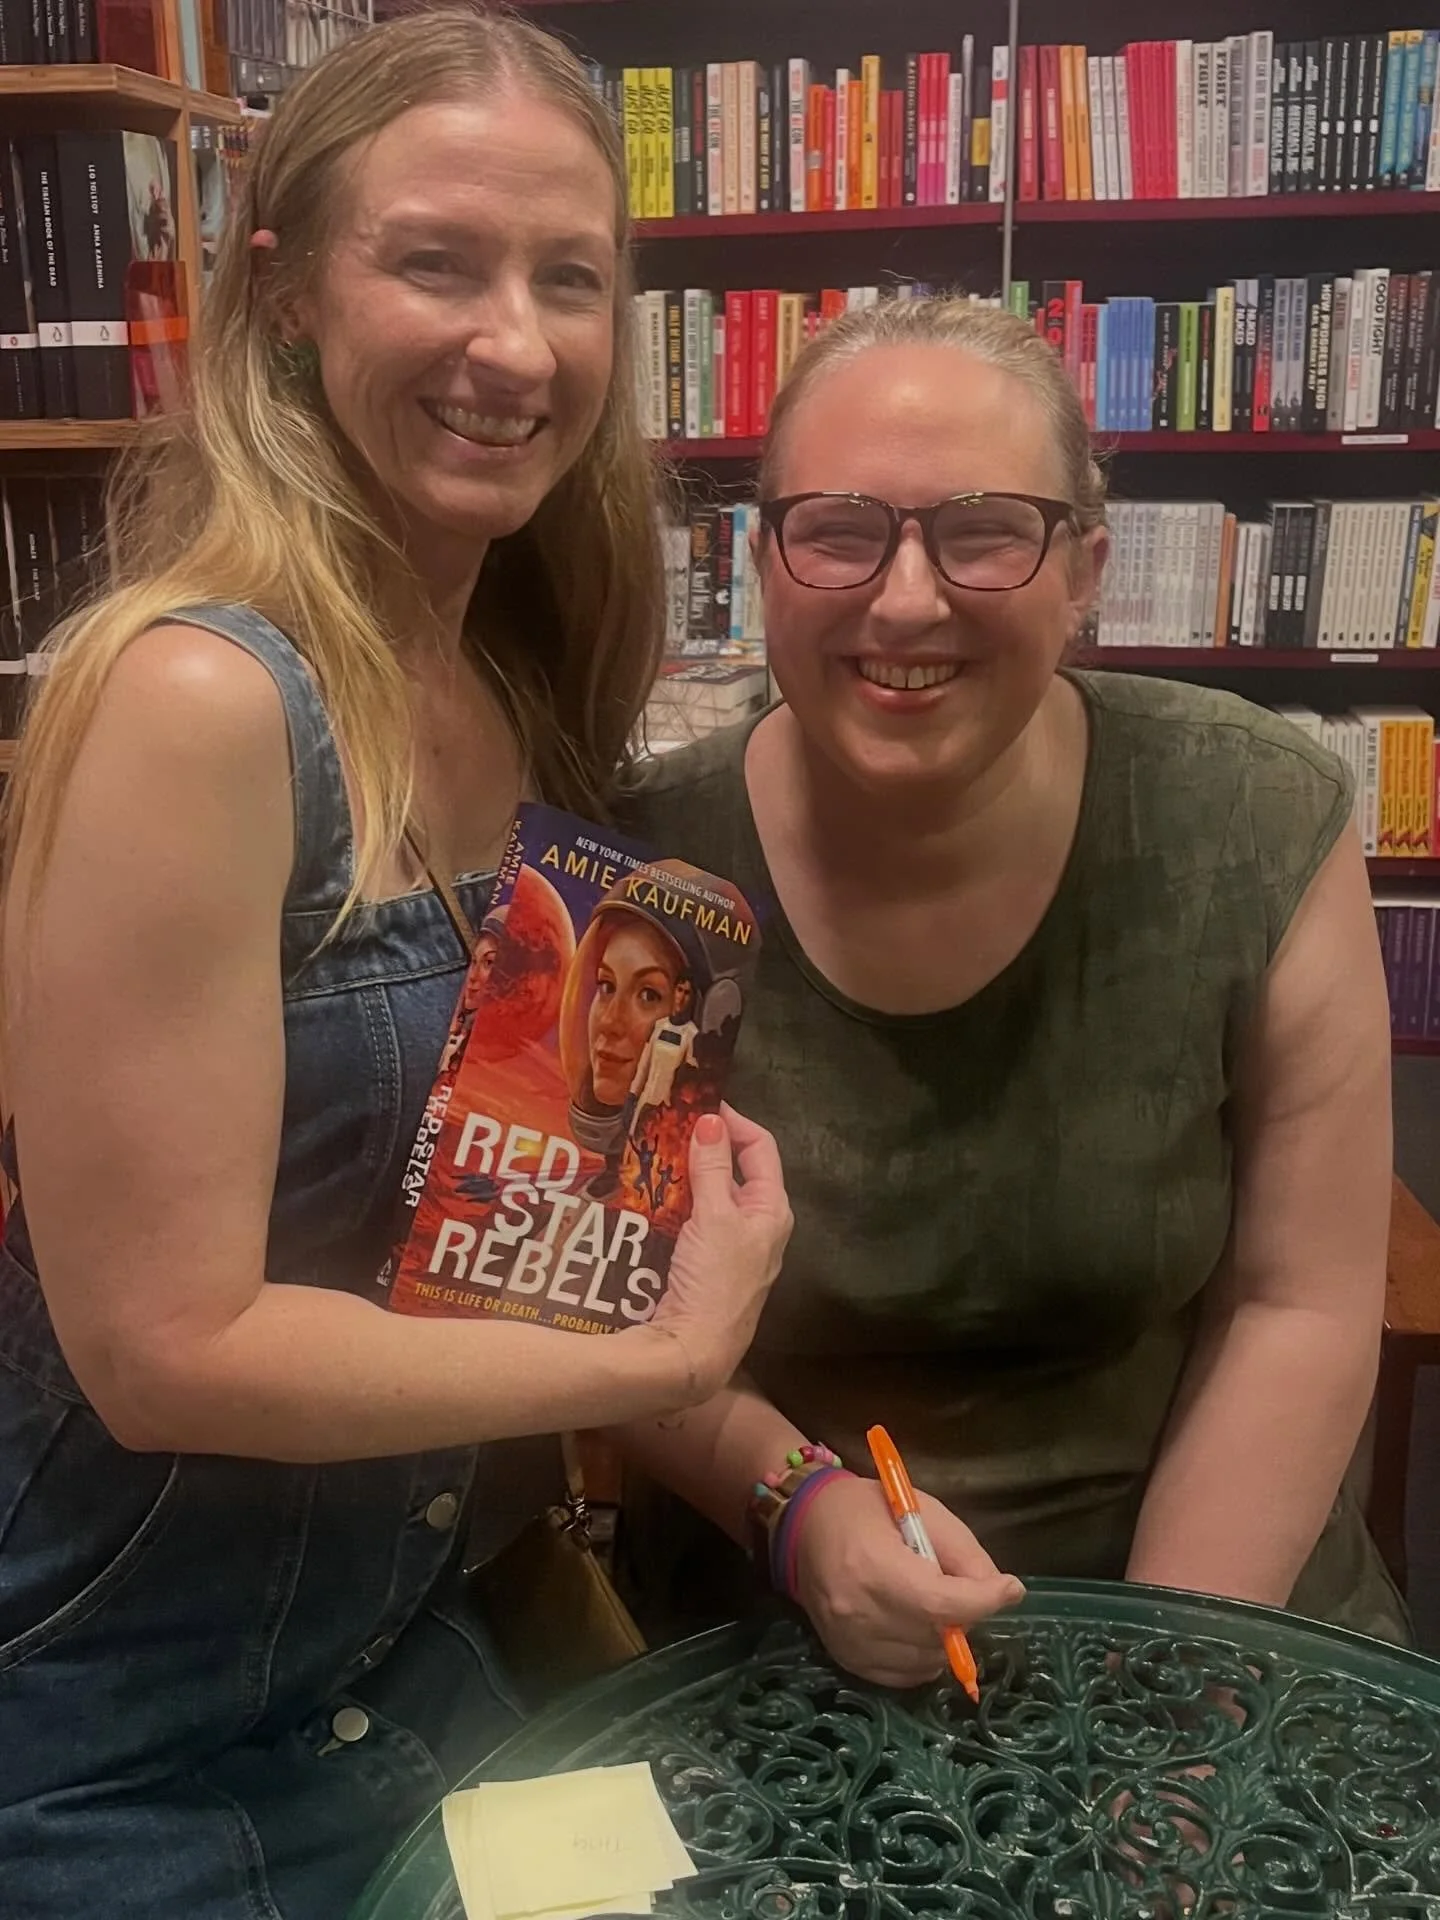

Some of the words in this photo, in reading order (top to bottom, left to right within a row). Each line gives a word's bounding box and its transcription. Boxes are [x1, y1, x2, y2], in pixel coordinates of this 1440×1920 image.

[658, 84, 672, 116] JUST
[1198, 52, 1209, 108] FIGHT
[1216, 51, 1228, 108] FIGHT
[626, 85, 639, 117] JUST
[641, 85, 656, 117] JUST
[645, 118, 656, 135] GO
[661, 117, 672, 134] GO
[88, 164, 96, 179] LEO
[90, 181, 99, 215] TOLSTOY
[44, 216, 53, 240] BOOK
[49, 266, 57, 287] DEAD
[96, 248, 104, 289] KARENINA
[1320, 283, 1332, 312] HOW
[1375, 275, 1388, 314] FOOD
[1235, 308, 1245, 345] NUKED
[1246, 308, 1257, 346] NUKED
[1317, 314, 1330, 376] PROGRESS
[1371, 316, 1385, 357] FIGHT
[1314, 378, 1327, 410] ENDS
[490, 820, 522, 906] KAUFMAN
[505, 841, 525, 885] AMIE
[575, 836, 600, 854] NEW
[598, 844, 623, 864] YORK
[622, 854, 650, 875] TIMES
[649, 866, 703, 898] BESTSELLING
[702, 889, 737, 911] AUTHOR
[540, 844, 618, 891] AMIE
[625, 876, 752, 946] KAUFMAN
[427, 1084, 453, 1135] RED
[453, 1111, 581, 1193] RED
[404, 1141, 436, 1208] STAR
[493, 1182, 650, 1268] STAR
[428, 1218, 662, 1322] REBELS
[415, 1282, 442, 1300] THIS
[443, 1285, 457, 1302] IS
[457, 1289, 482, 1309] LIFE
[483, 1296, 502, 1314] OR
[553, 1312, 613, 1337] PROBABLY
